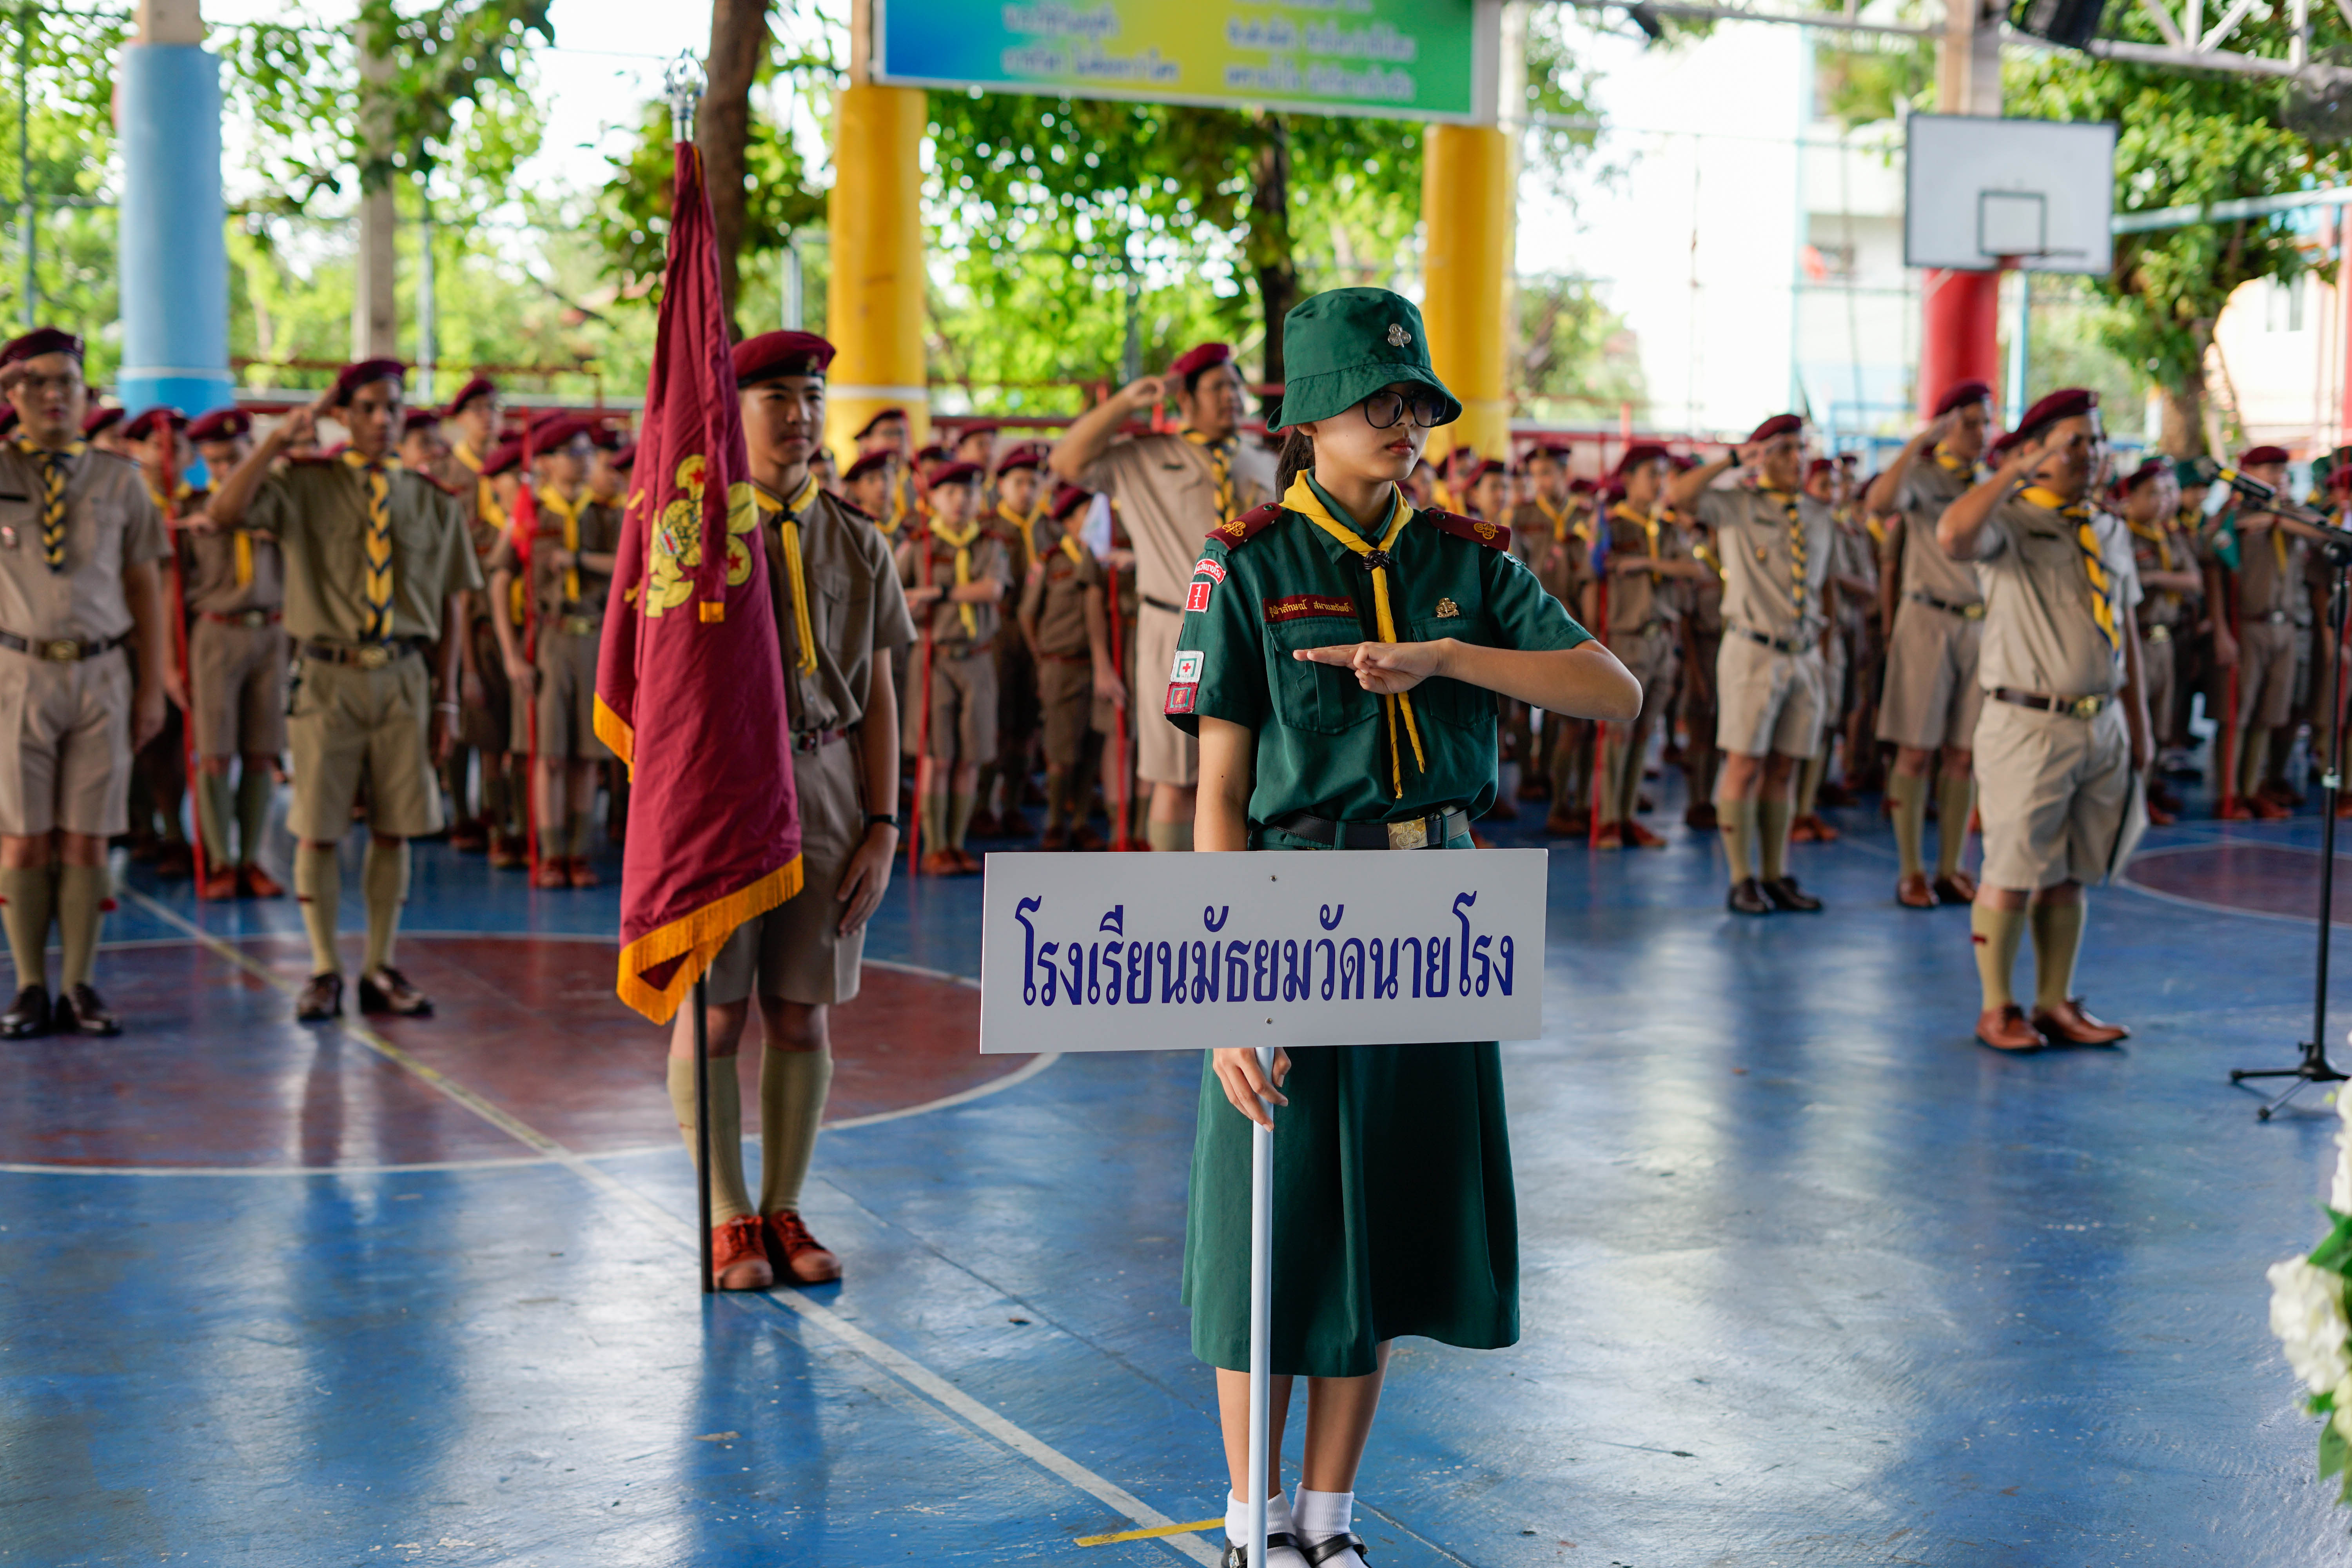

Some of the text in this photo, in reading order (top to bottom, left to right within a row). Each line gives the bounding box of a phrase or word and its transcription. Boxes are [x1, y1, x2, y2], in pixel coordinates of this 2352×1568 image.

[1194, 585, 1201, 597] 1
[1193, 597, 1200, 608] 1
[1015, 891, 1514, 1006] โรงเรียนมัธยมวัดนายโรง
